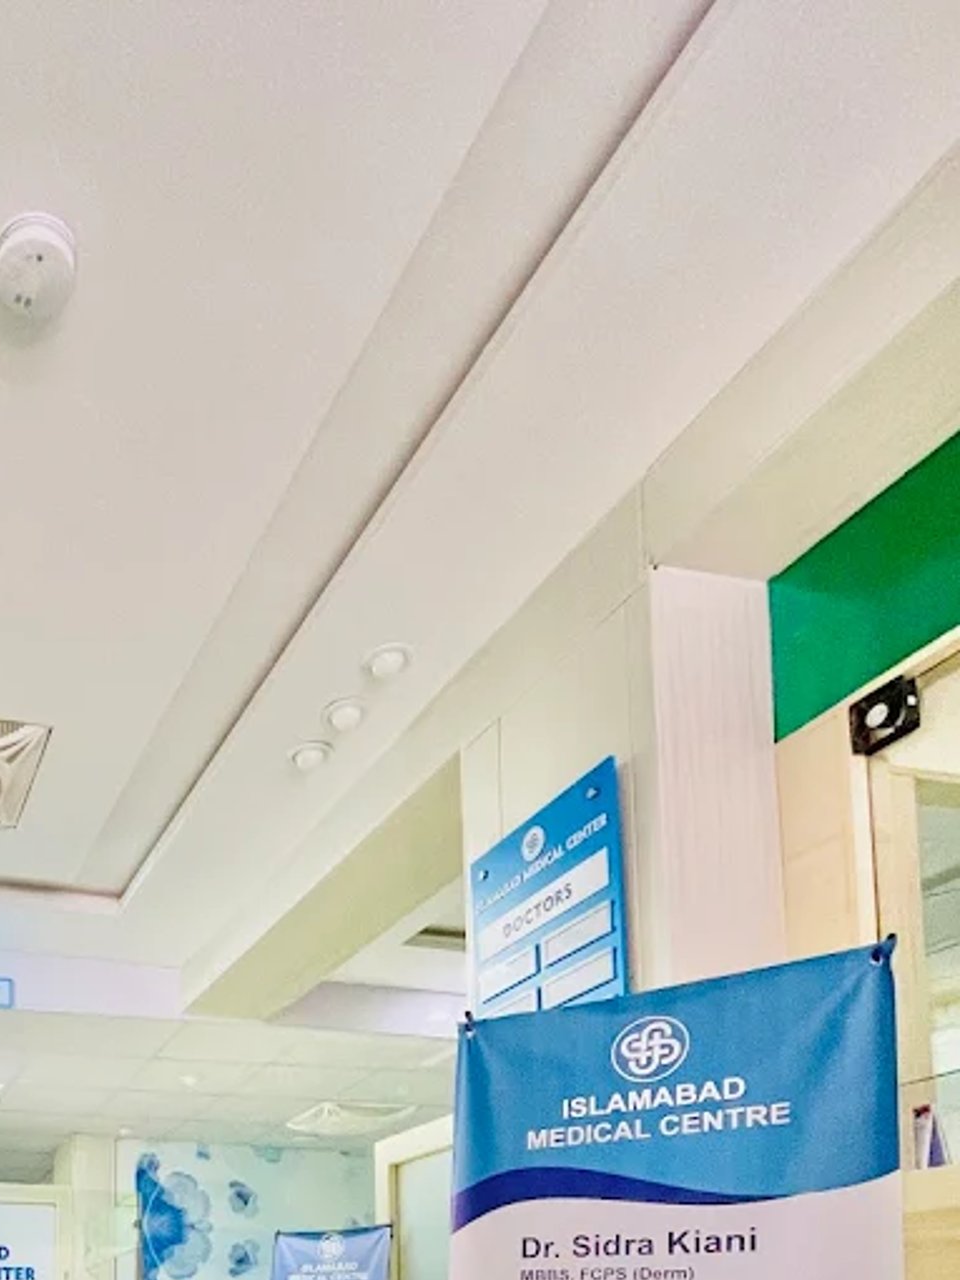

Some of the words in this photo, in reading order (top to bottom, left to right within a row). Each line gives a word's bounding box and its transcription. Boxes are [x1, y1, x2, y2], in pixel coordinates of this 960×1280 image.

[502, 882, 573, 938] DOCTORS
[561, 1076, 746, 1119] ISLAMABAD
[526, 1121, 651, 1150] MEDICAL
[660, 1101, 791, 1136] CENTRE
[521, 1237, 560, 1259] Dr.
[572, 1234, 654, 1257] Sidra
[668, 1226, 758, 1255] Kiani
[580, 1267, 627, 1280] FCPS
